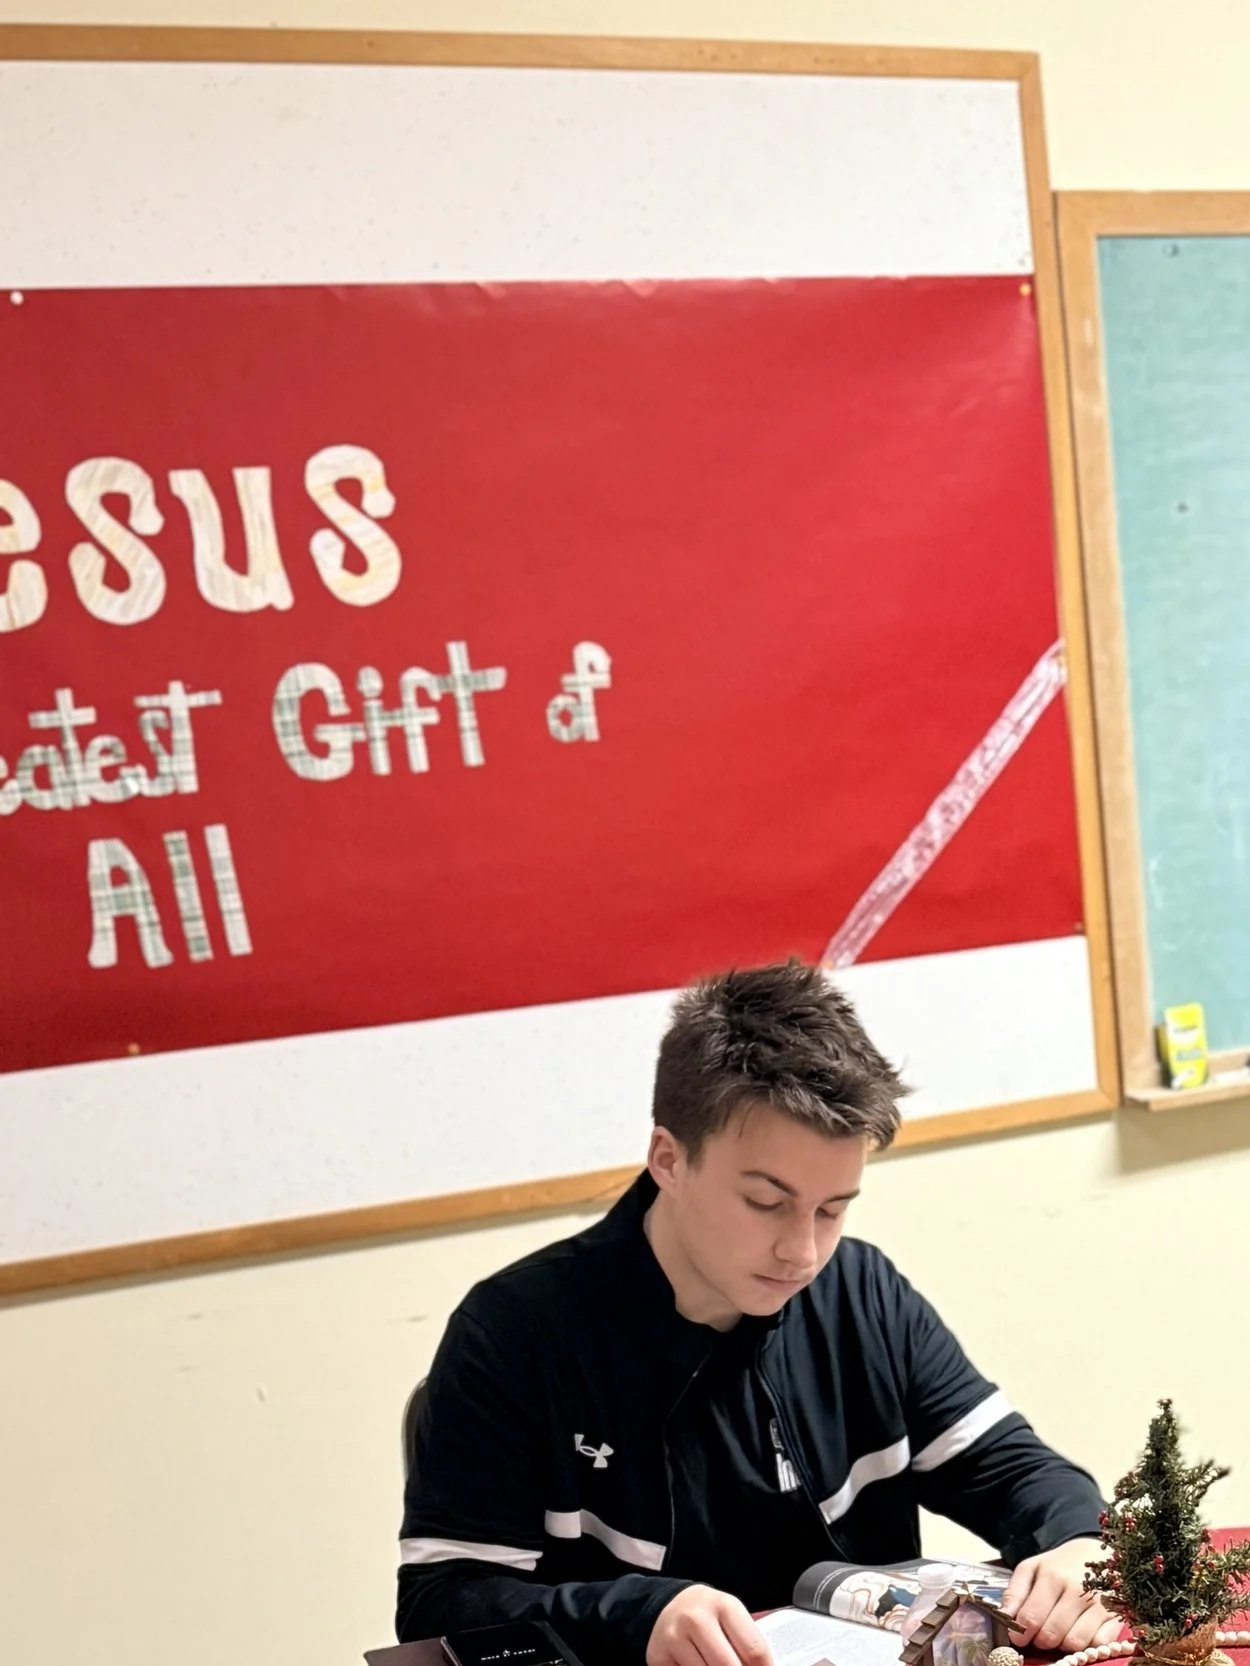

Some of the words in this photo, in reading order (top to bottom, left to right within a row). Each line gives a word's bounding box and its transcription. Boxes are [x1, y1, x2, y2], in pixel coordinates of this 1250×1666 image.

[272, 640, 507, 782] Gift
[546, 641, 612, 743] of
[87, 823, 253, 969] All
